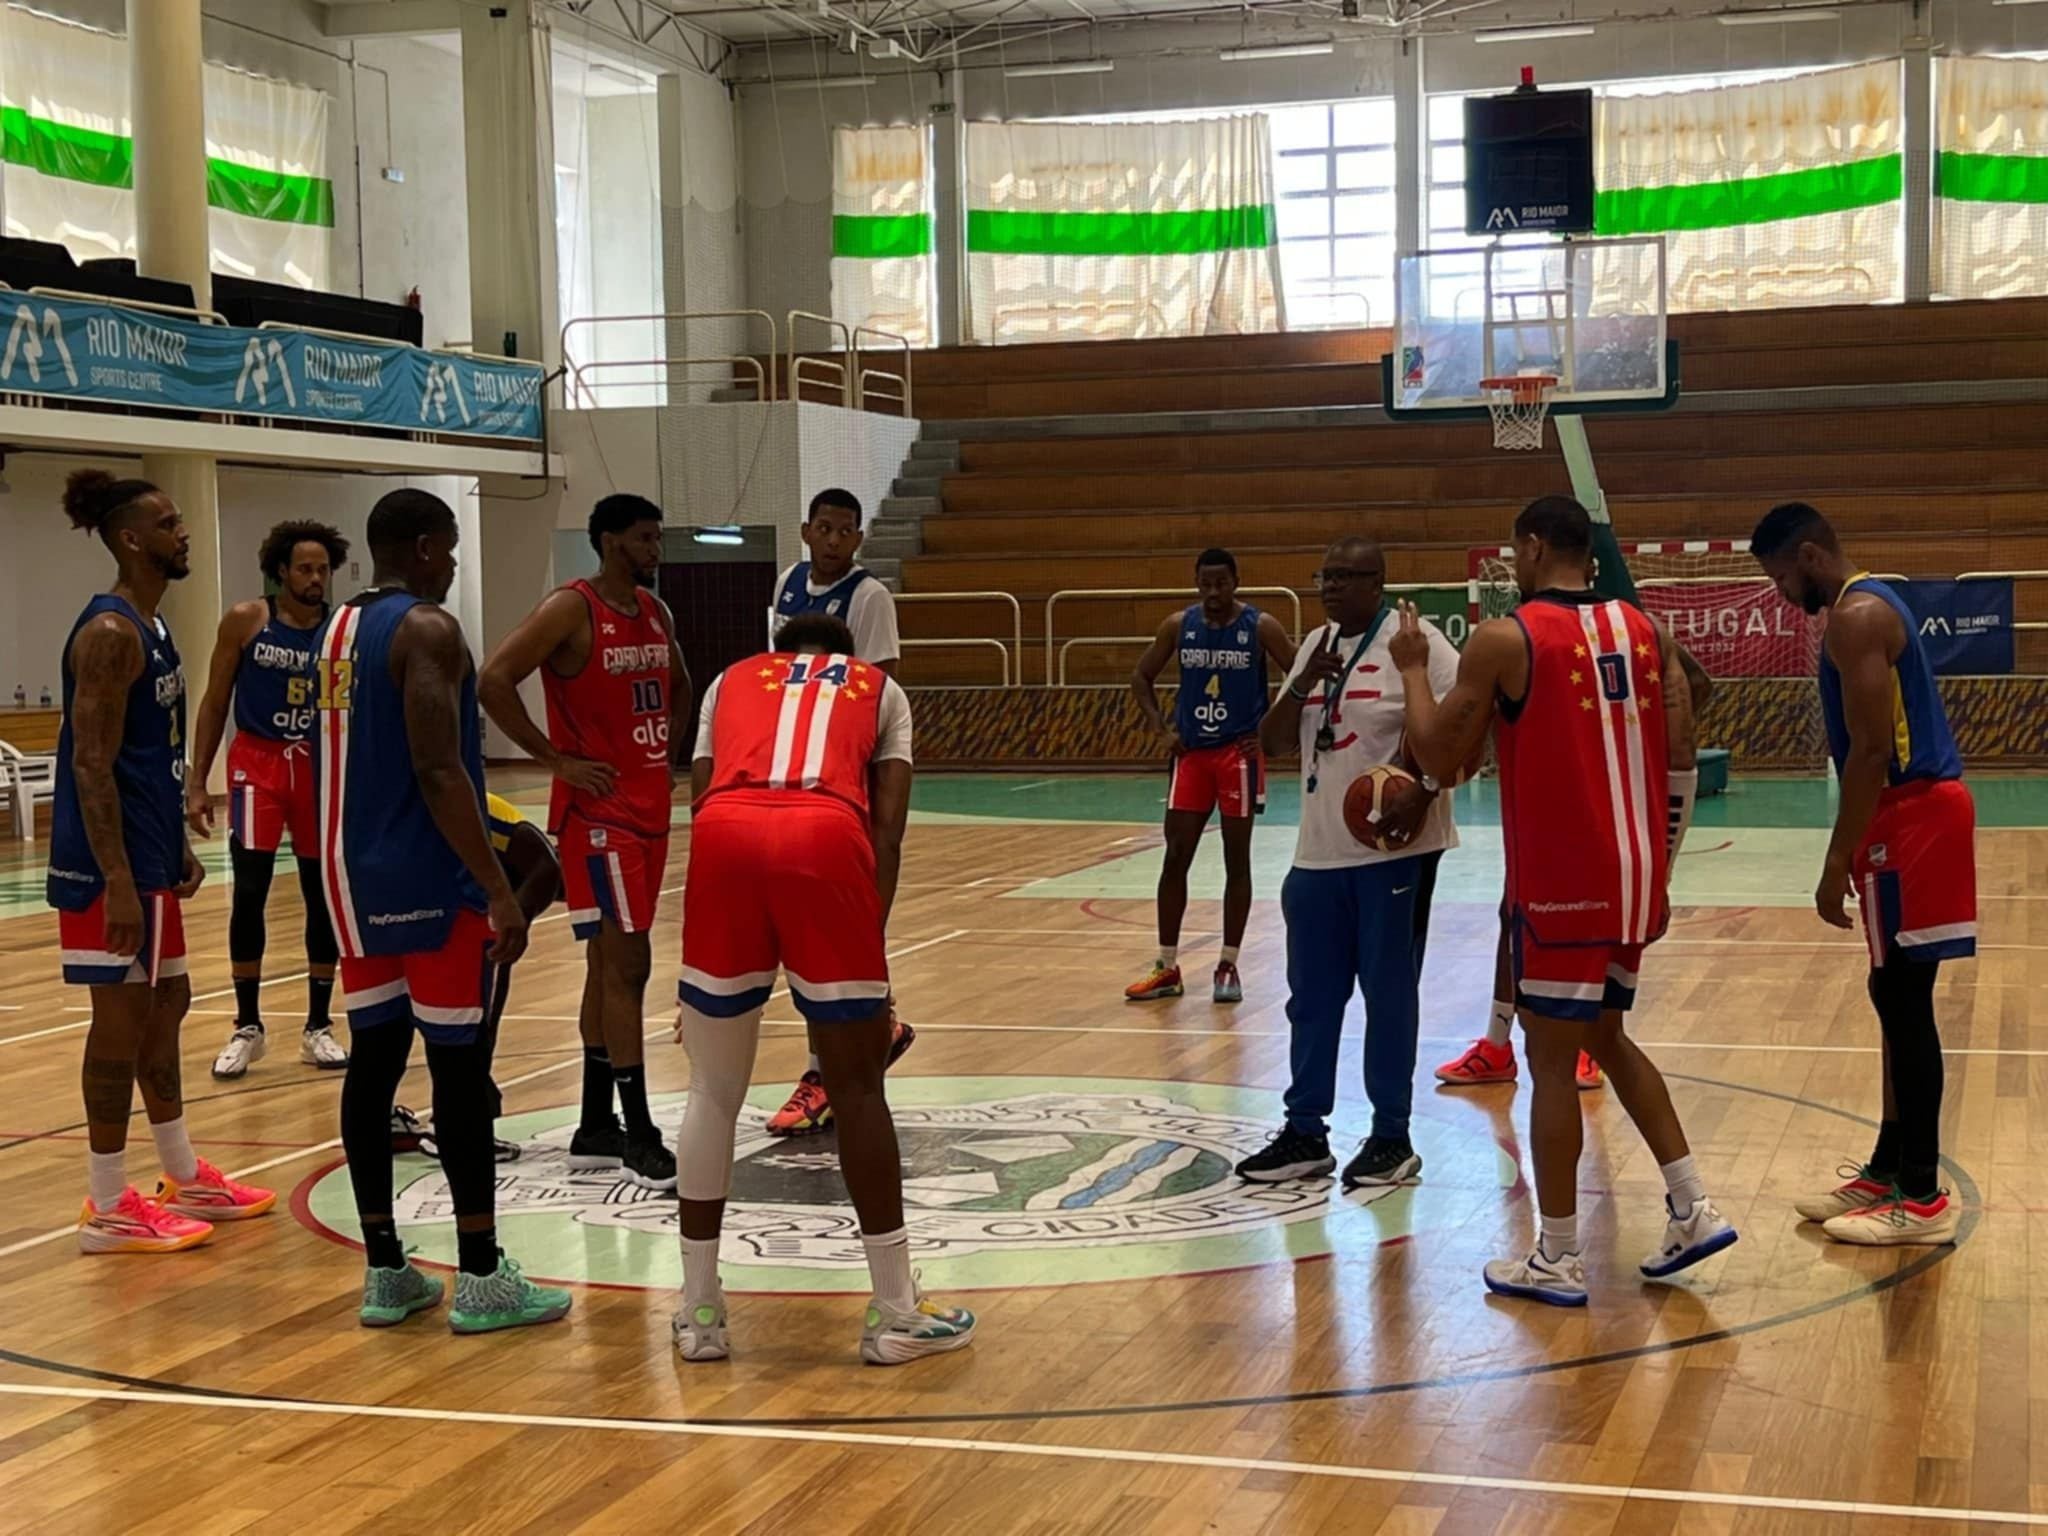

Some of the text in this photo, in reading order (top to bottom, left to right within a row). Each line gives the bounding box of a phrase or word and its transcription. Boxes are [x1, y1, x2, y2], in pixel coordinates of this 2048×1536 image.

[1521, 204, 1569, 218] RIO MAIOR
[87, 317, 188, 368] RIO MAIOR
[89, 366, 126, 388] SPORTS
[304, 344, 383, 389] RIO MAIOR
[473, 371, 497, 403] RIO
[1648, 607, 1796, 639] TUGAL
[784, 662, 848, 686] 14
[1211, 649, 1251, 669] VERDE
[286, 677, 306, 705] 6
[315, 659, 353, 710] 12
[1204, 674, 1221, 699] 4
[1596, 653, 1629, 701] 0
[631, 678, 665, 716] 10
[981, 1199, 1269, 1238] CIDADE
